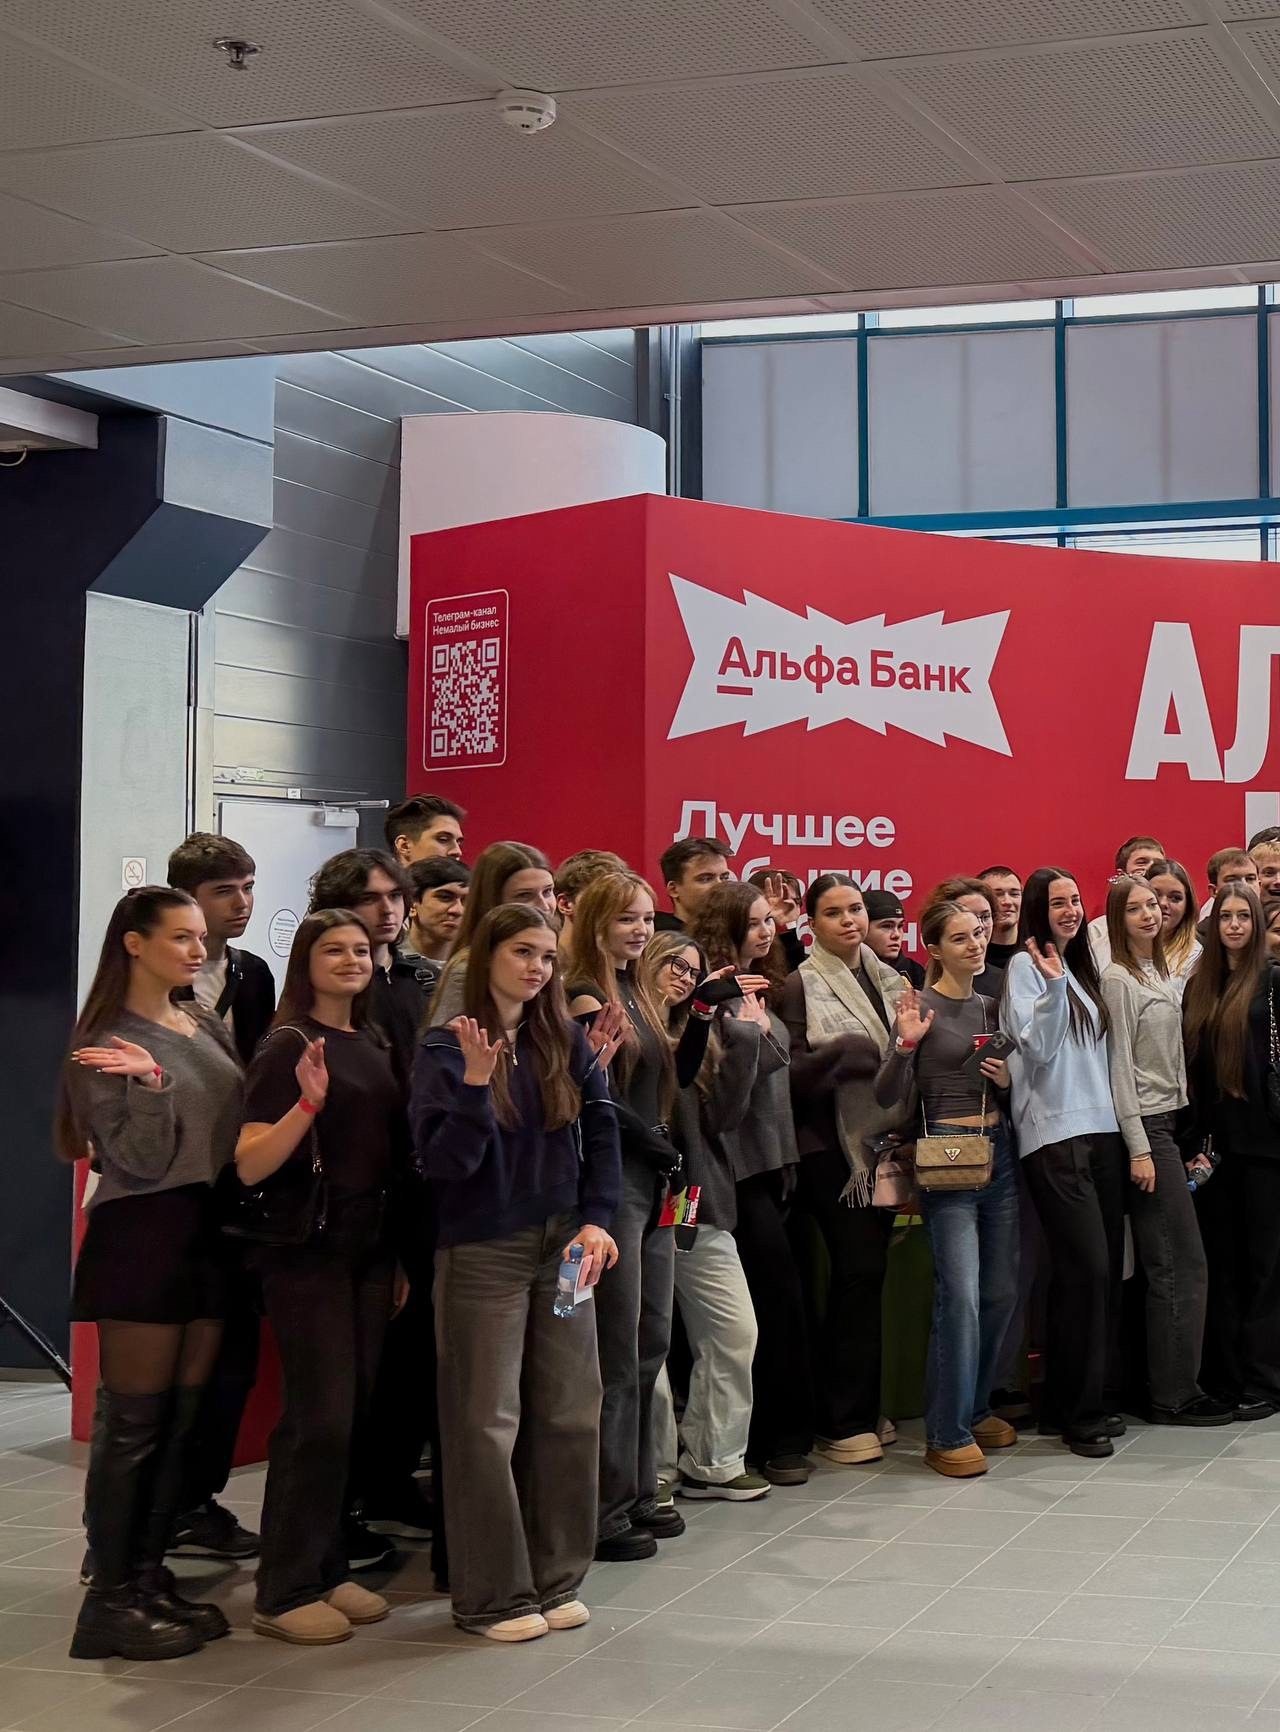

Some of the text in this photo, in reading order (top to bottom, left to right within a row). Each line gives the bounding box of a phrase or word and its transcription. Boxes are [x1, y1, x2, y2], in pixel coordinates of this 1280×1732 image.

[432, 606, 497, 623] Телеграм-канал
[432, 619, 500, 635] Немалый бизнес
[717, 636, 972, 694] Альфа Банк
[673, 800, 896, 857] Лучшее
